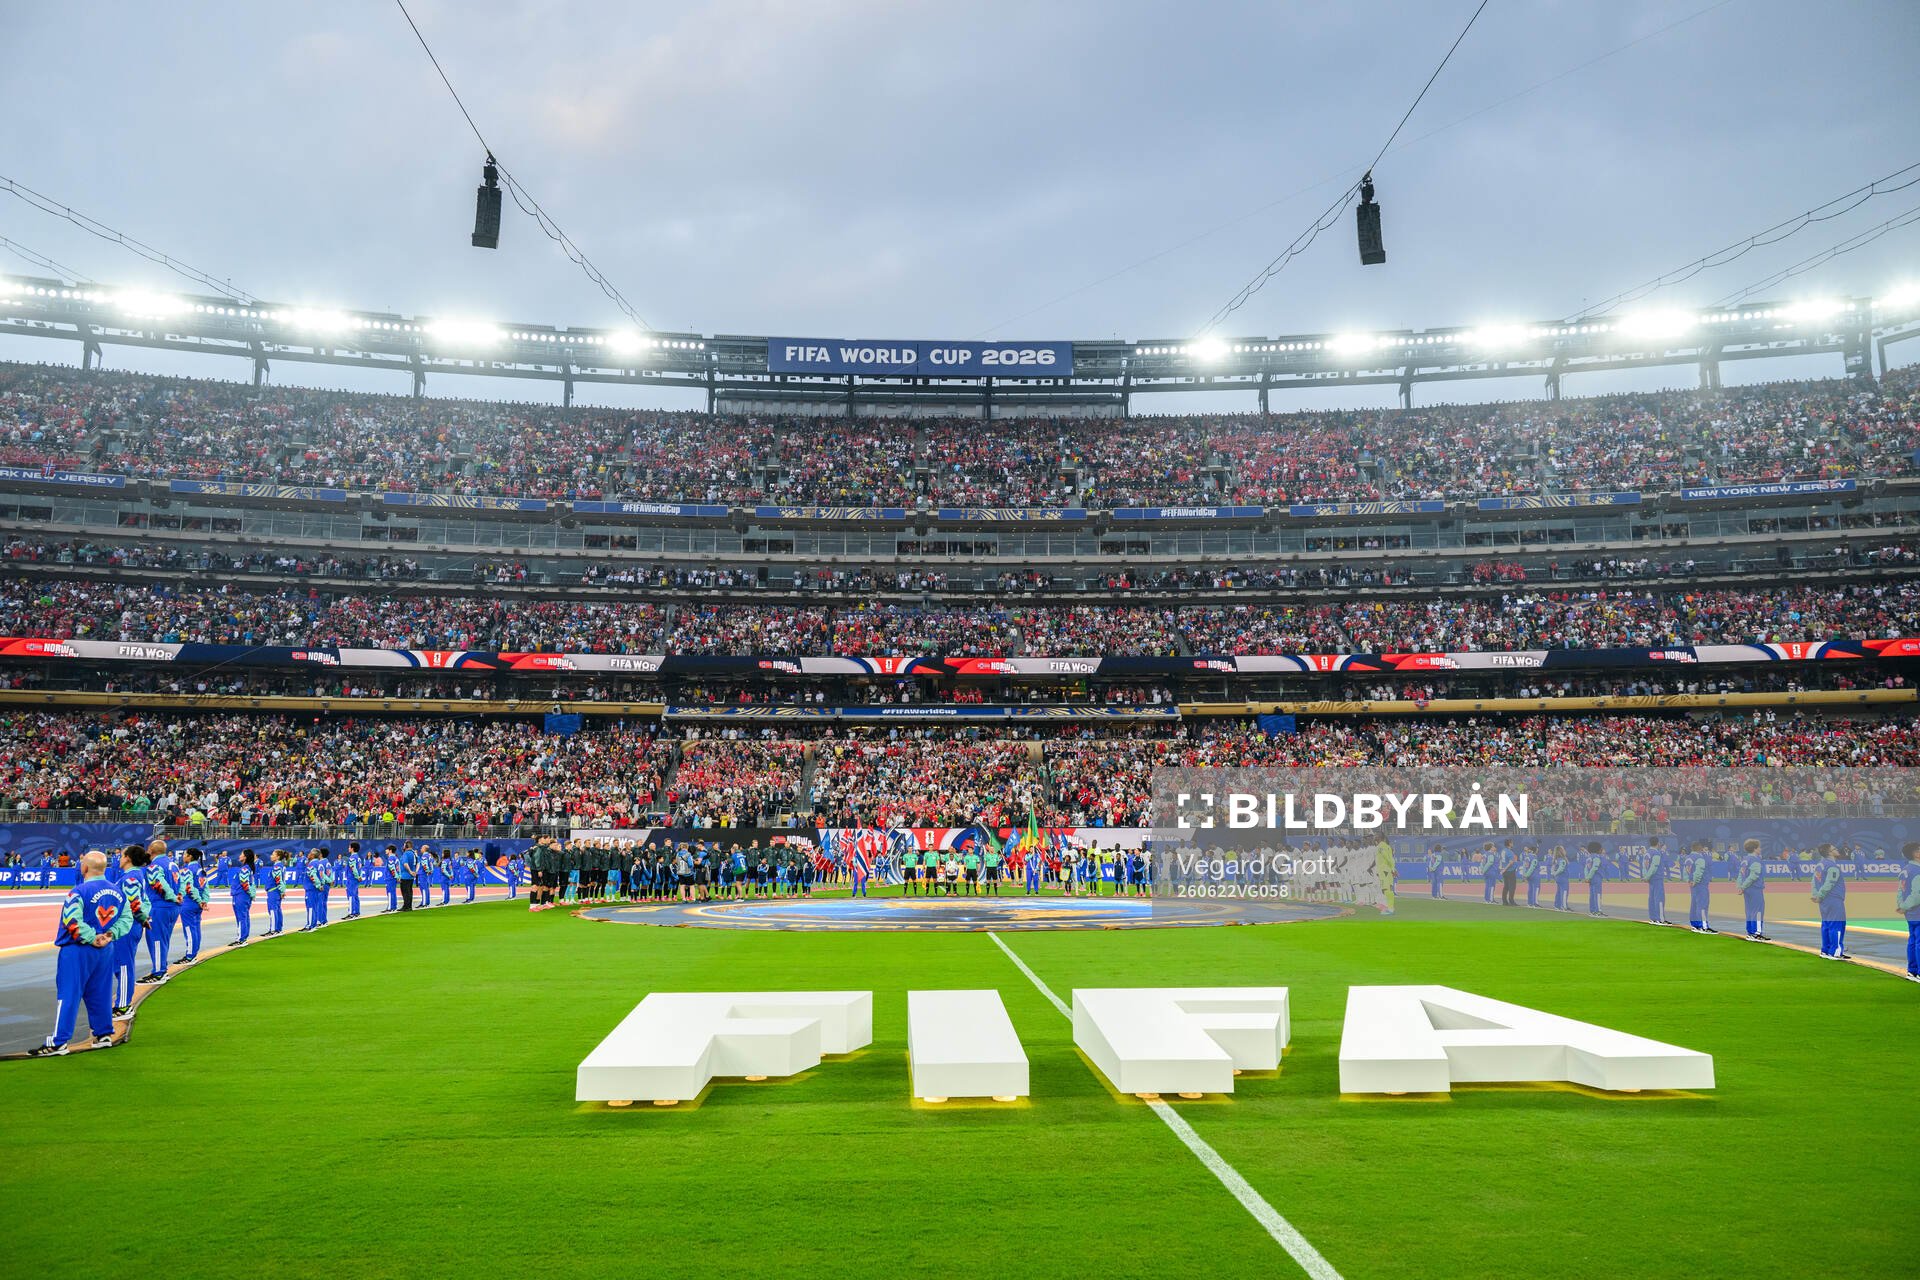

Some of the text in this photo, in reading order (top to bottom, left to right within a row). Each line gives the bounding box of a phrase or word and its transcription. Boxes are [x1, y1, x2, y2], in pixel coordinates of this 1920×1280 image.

[785, 346, 1056, 365] FIFA WORLD CUP 2026
[59, 474, 116, 484] JERSEY
[1688, 482, 1847, 498] NEW YORK NEW JERSEY
[622, 503, 680, 515] #FIFAWorldCup
[1160, 507, 1217, 518] #FIFAWorldCup
[119, 646, 174, 660] FIFA WOR
[610, 658, 660, 671] FIFA WOR
[1493, 655, 1543, 667] FIFA WOR
[1050, 662, 1097, 674] FIFA WOR
[1765, 864, 1792, 874] FIFA
[90, 888, 124, 904] VOLUNTEER
[575, 984, 1715, 1103] FIFA
